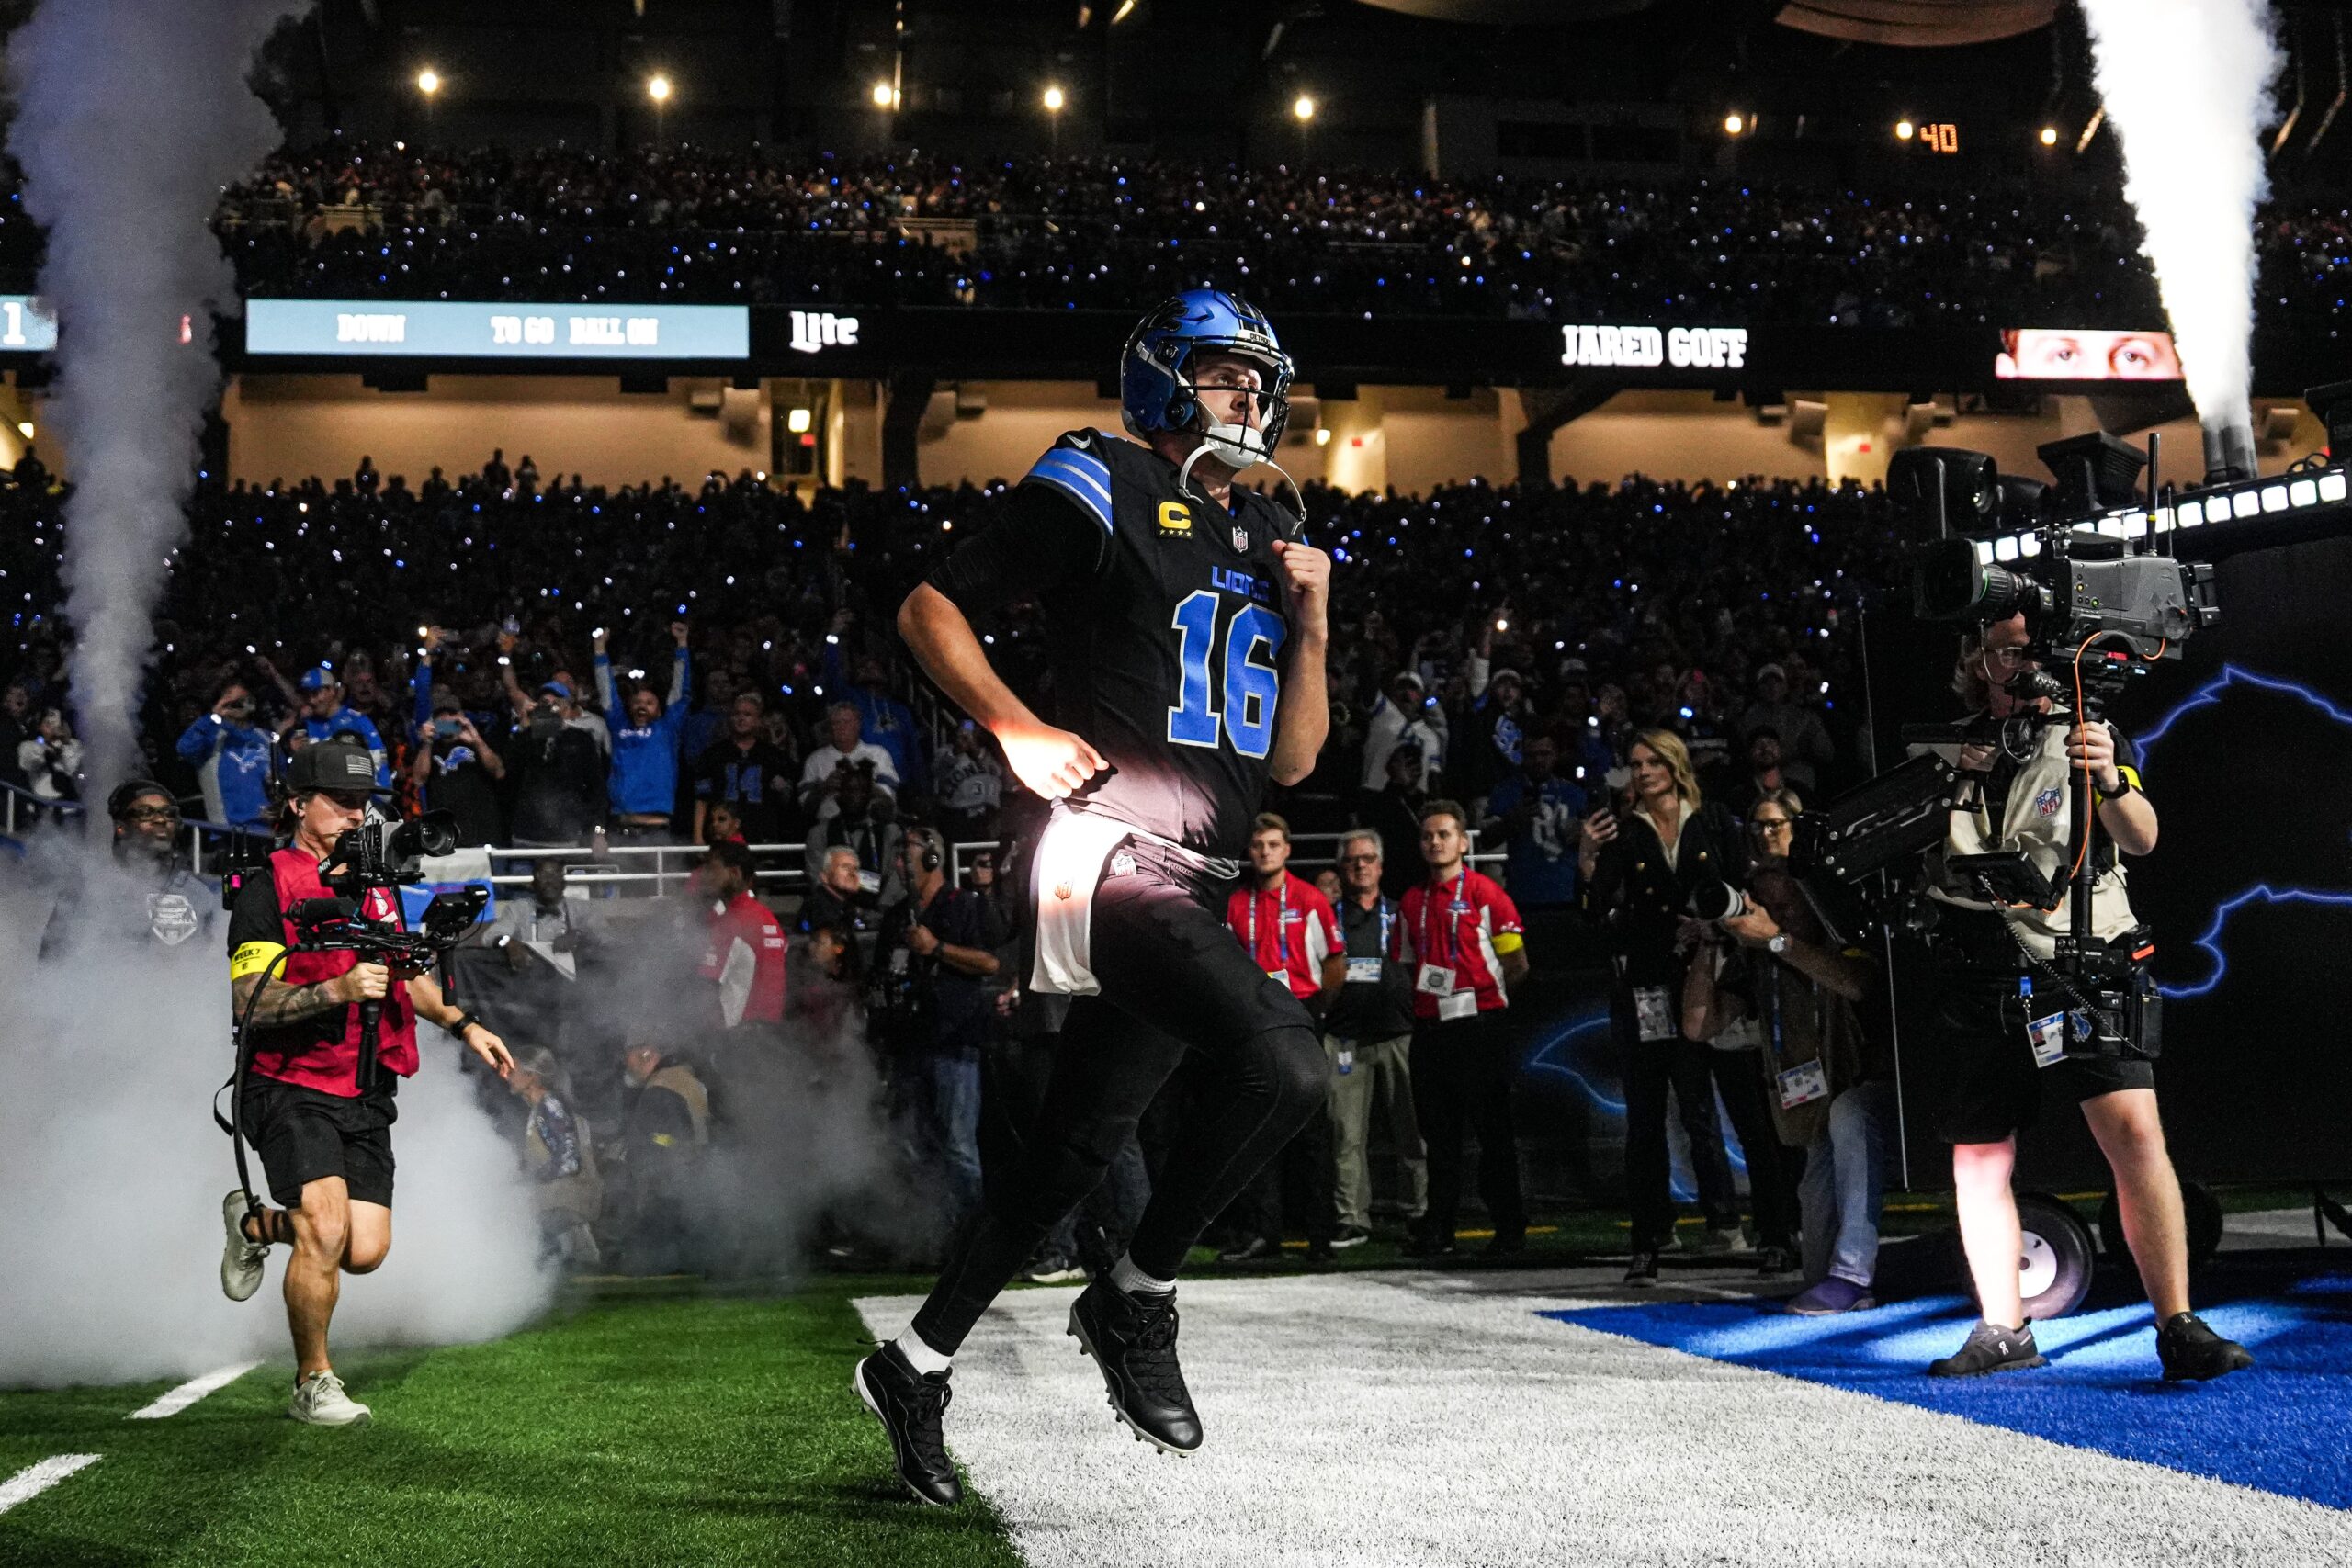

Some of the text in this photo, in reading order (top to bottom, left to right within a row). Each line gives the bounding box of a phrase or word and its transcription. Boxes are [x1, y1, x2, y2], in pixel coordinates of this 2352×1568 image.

[1920, 123, 1958, 153] 40
[3, 301, 26, 345] 1
[337, 314, 406, 342] DOWN
[490, 316, 554, 344] TO GO
[569, 317, 626, 344] BALL
[789, 310, 859, 354] Lite
[1562, 324, 1748, 367] JARED GOFF
[1158, 501, 1192, 530] C
[1168, 589, 1287, 760] 16
[2040, 796, 2060, 816] NFL
[233, 949, 254, 962] WEEK
